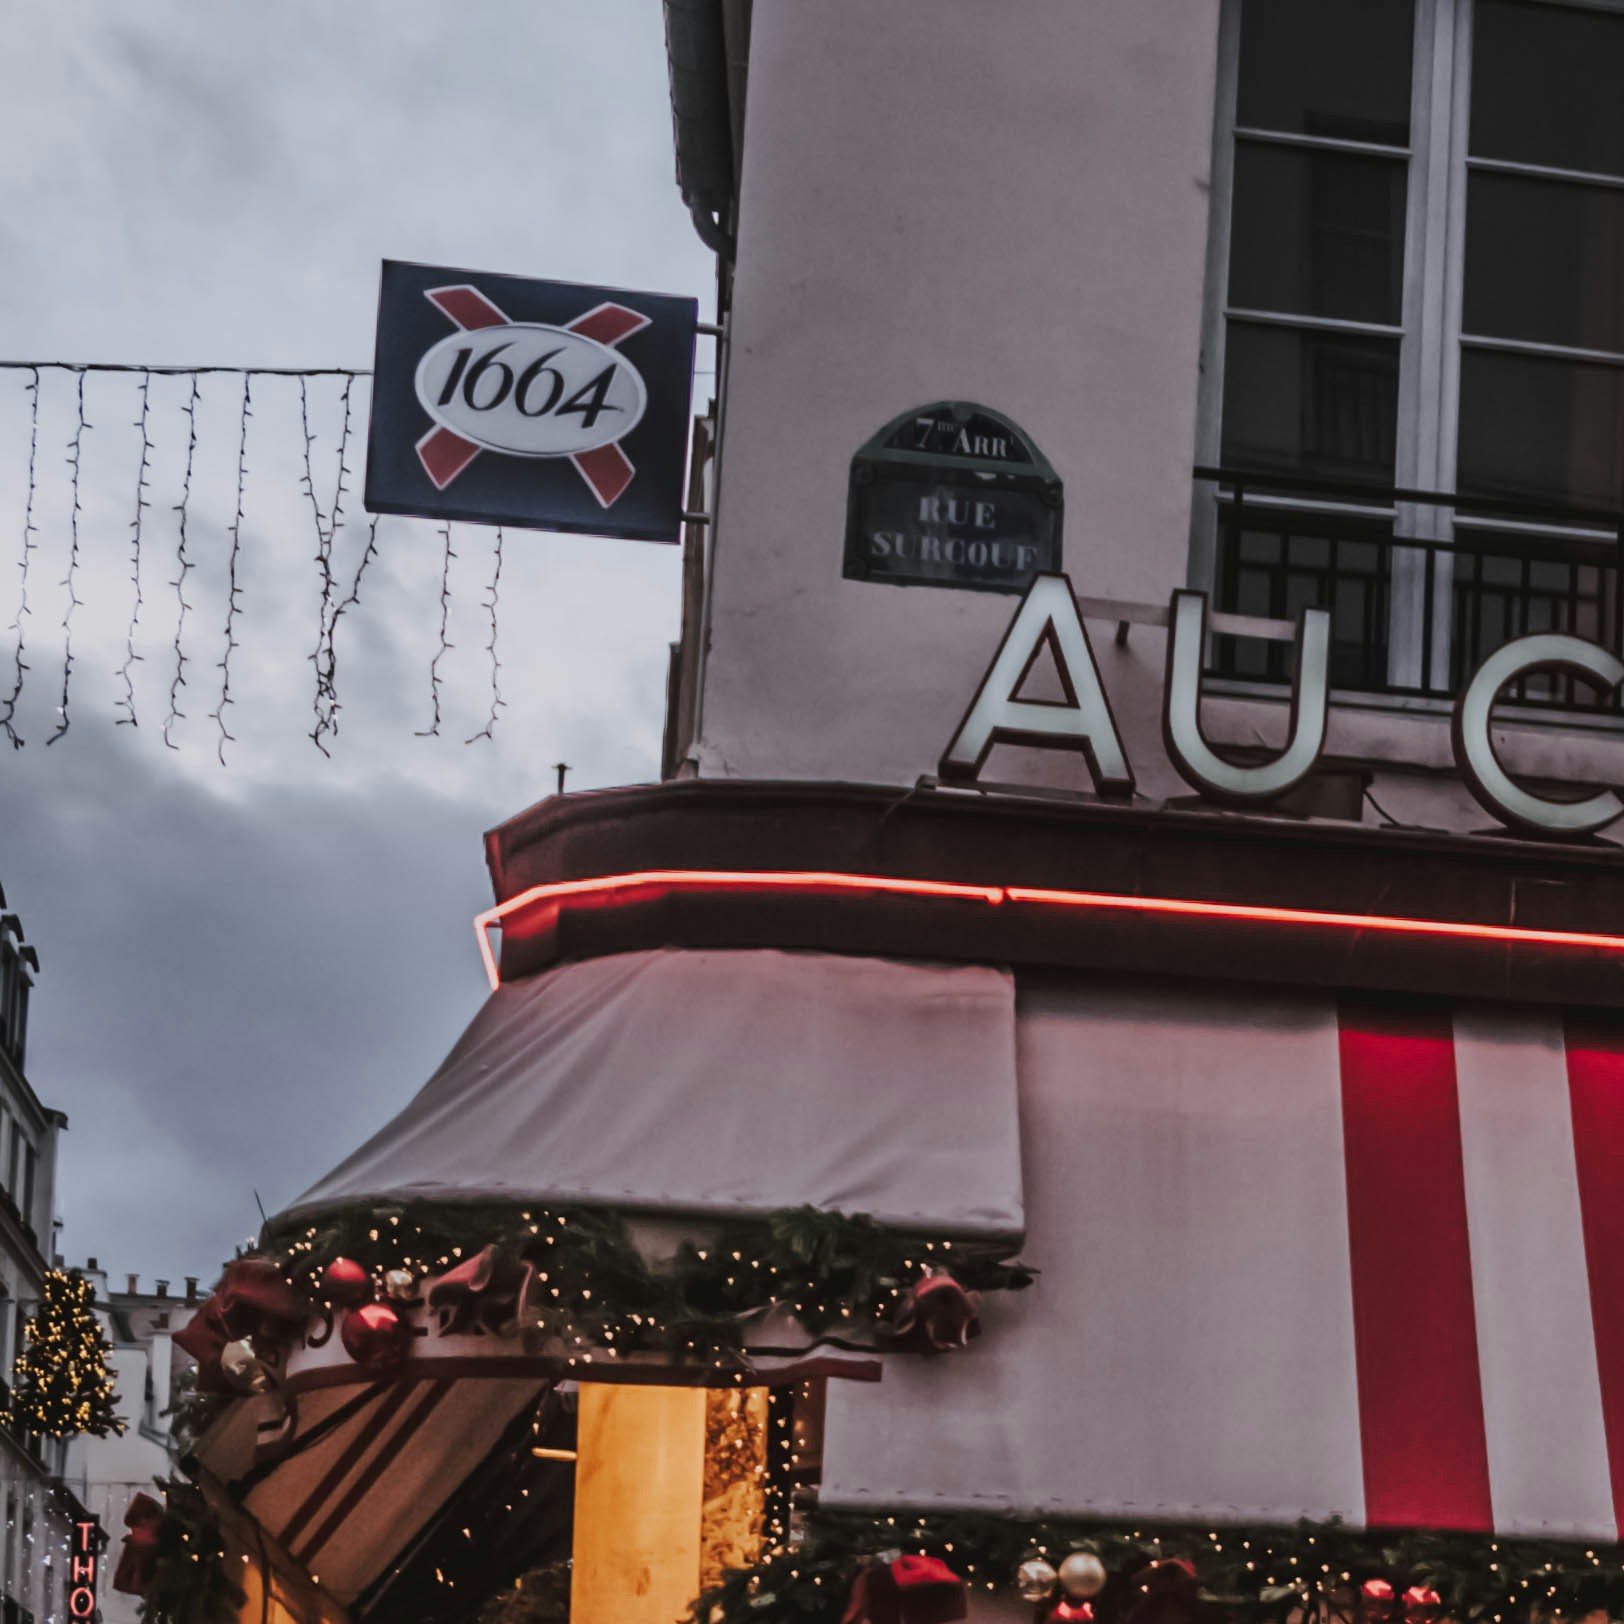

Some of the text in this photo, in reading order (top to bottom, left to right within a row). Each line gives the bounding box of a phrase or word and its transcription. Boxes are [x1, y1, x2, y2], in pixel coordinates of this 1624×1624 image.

[437, 341, 625, 429] 1664
[919, 496, 996, 528] RUE
[938, 572, 1331, 804] AU
